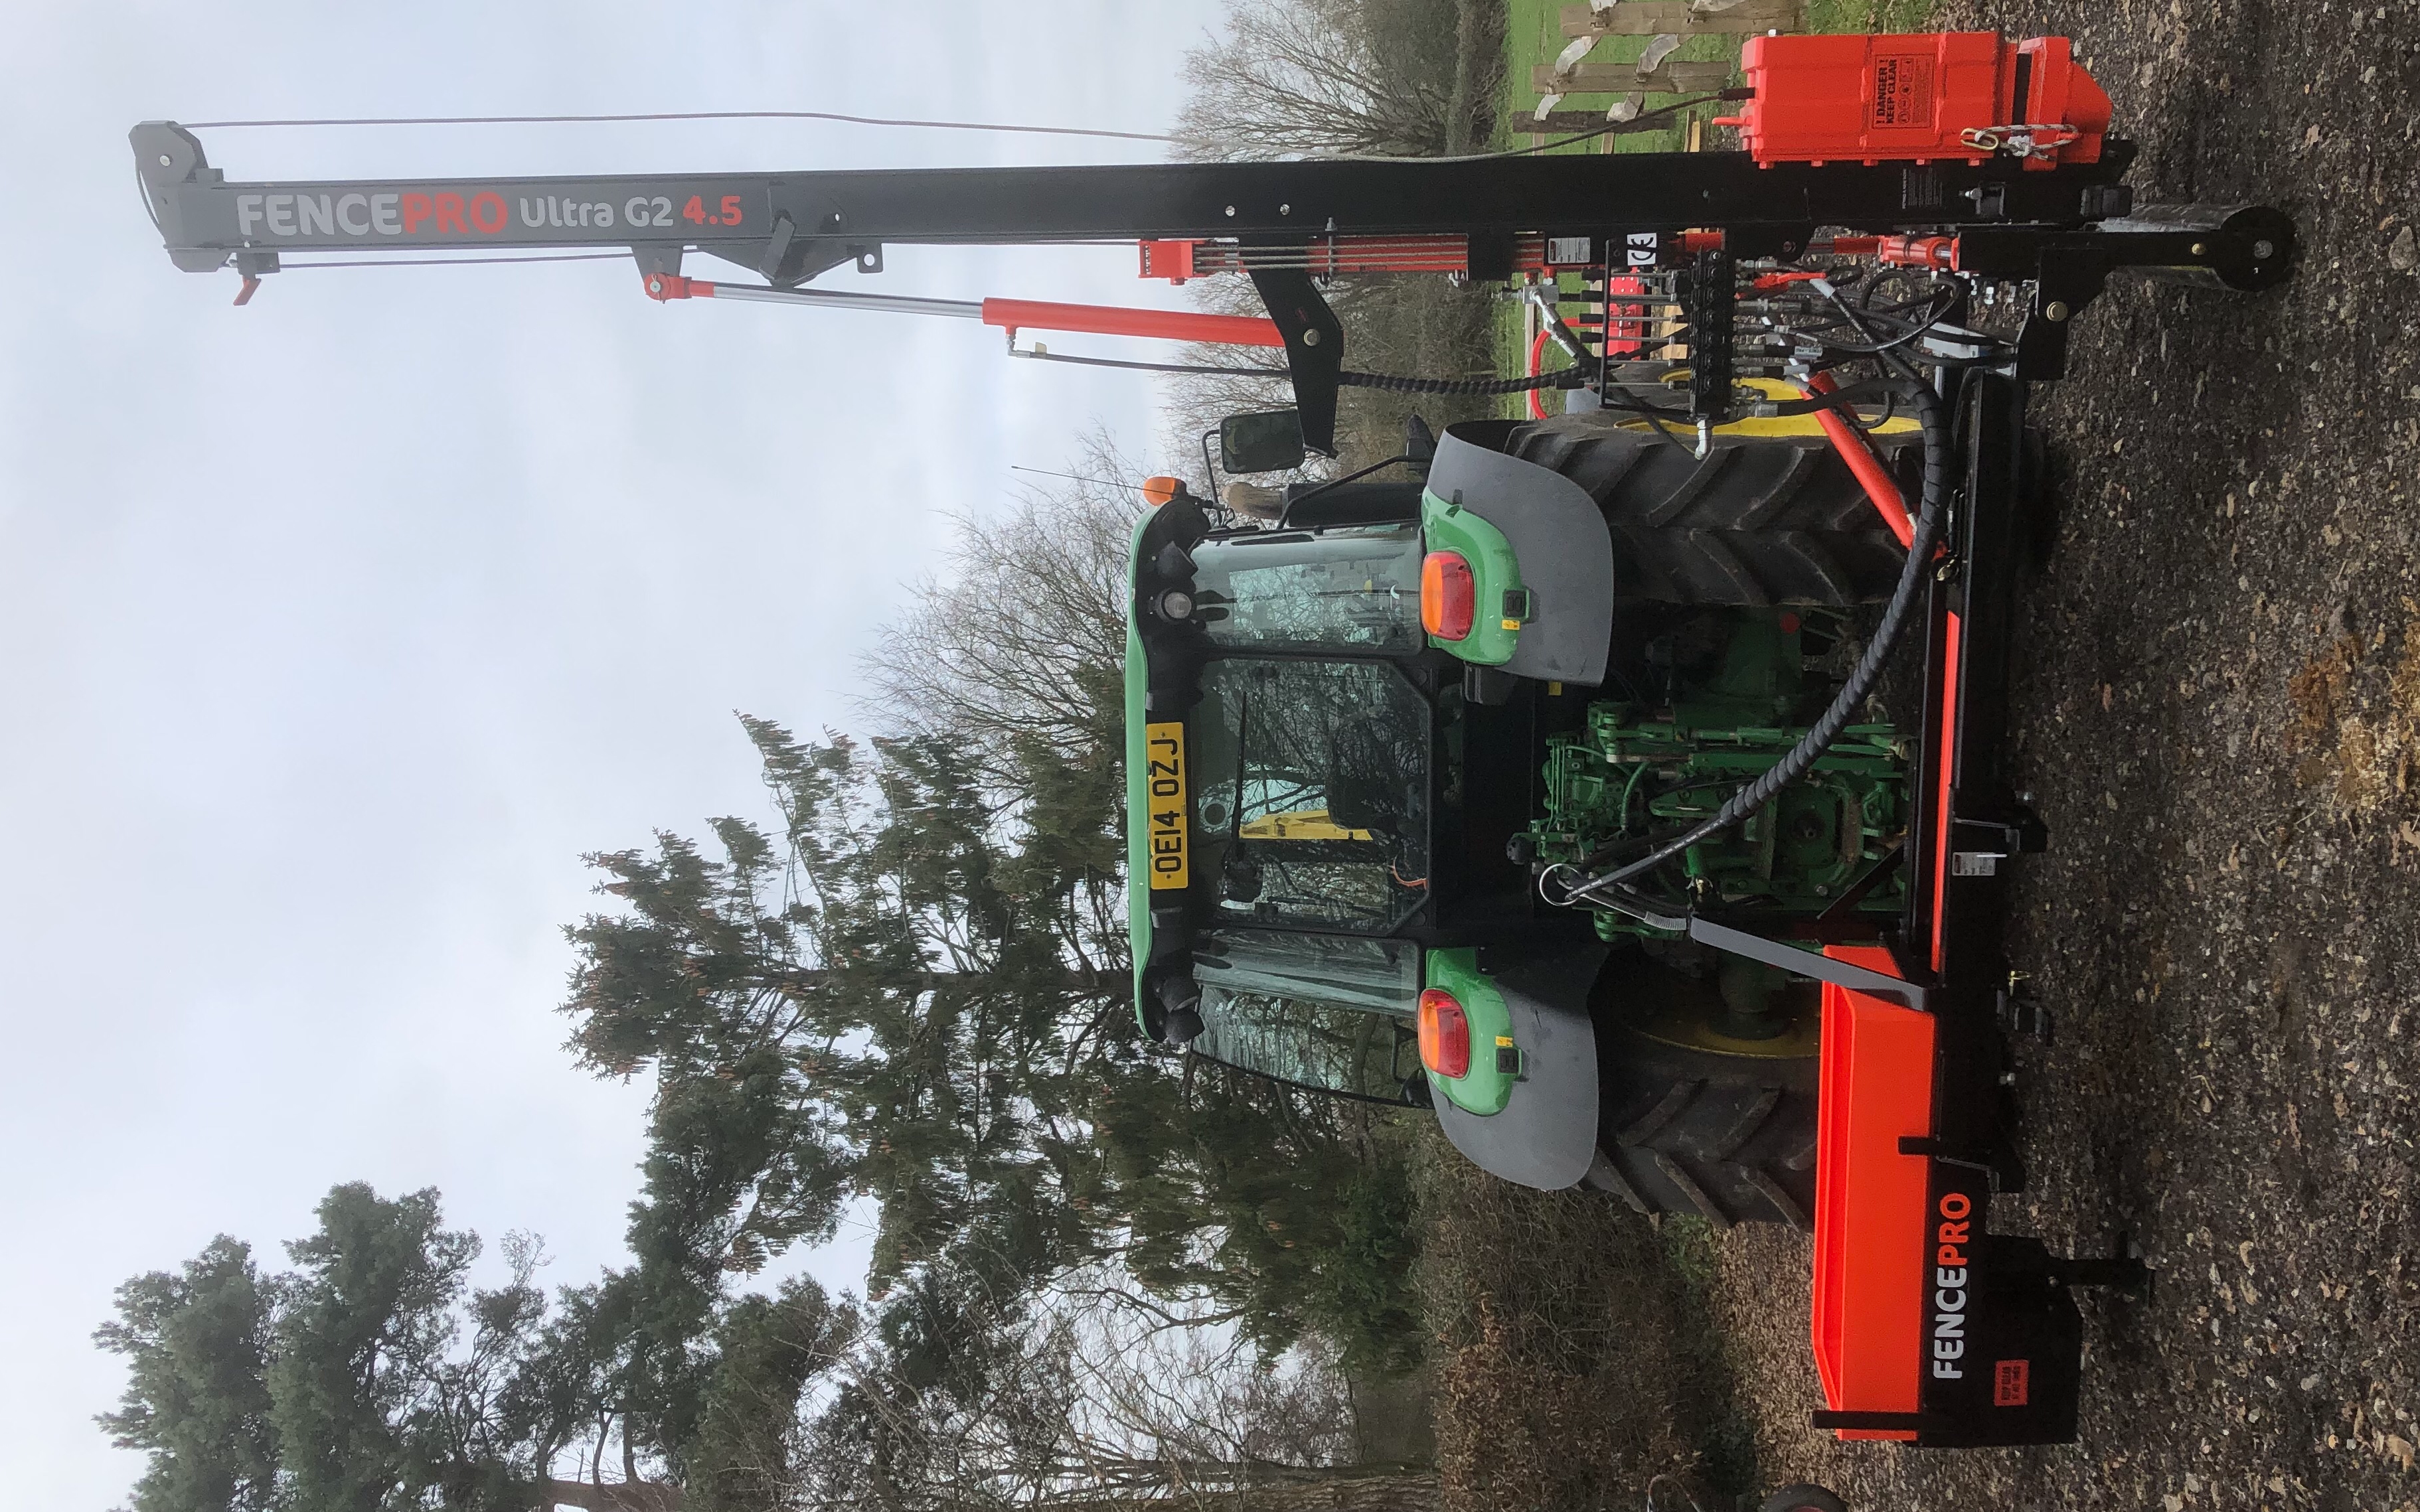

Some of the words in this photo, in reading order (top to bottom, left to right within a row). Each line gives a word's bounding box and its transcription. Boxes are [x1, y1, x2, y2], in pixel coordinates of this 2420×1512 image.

[1876, 67, 1888, 117] DANGER
[1888, 59, 1897, 94] CLEAR
[1886, 96, 1895, 124] KEEP
[236, 191, 509, 236] FENCEPRO
[519, 196, 614, 228] Ultra
[624, 196, 674, 227] G2
[682, 194, 742, 226] 4.5
[1151, 739, 1179, 797] OZJ
[1933, 1193, 1971, 1379] FENCEPRO
